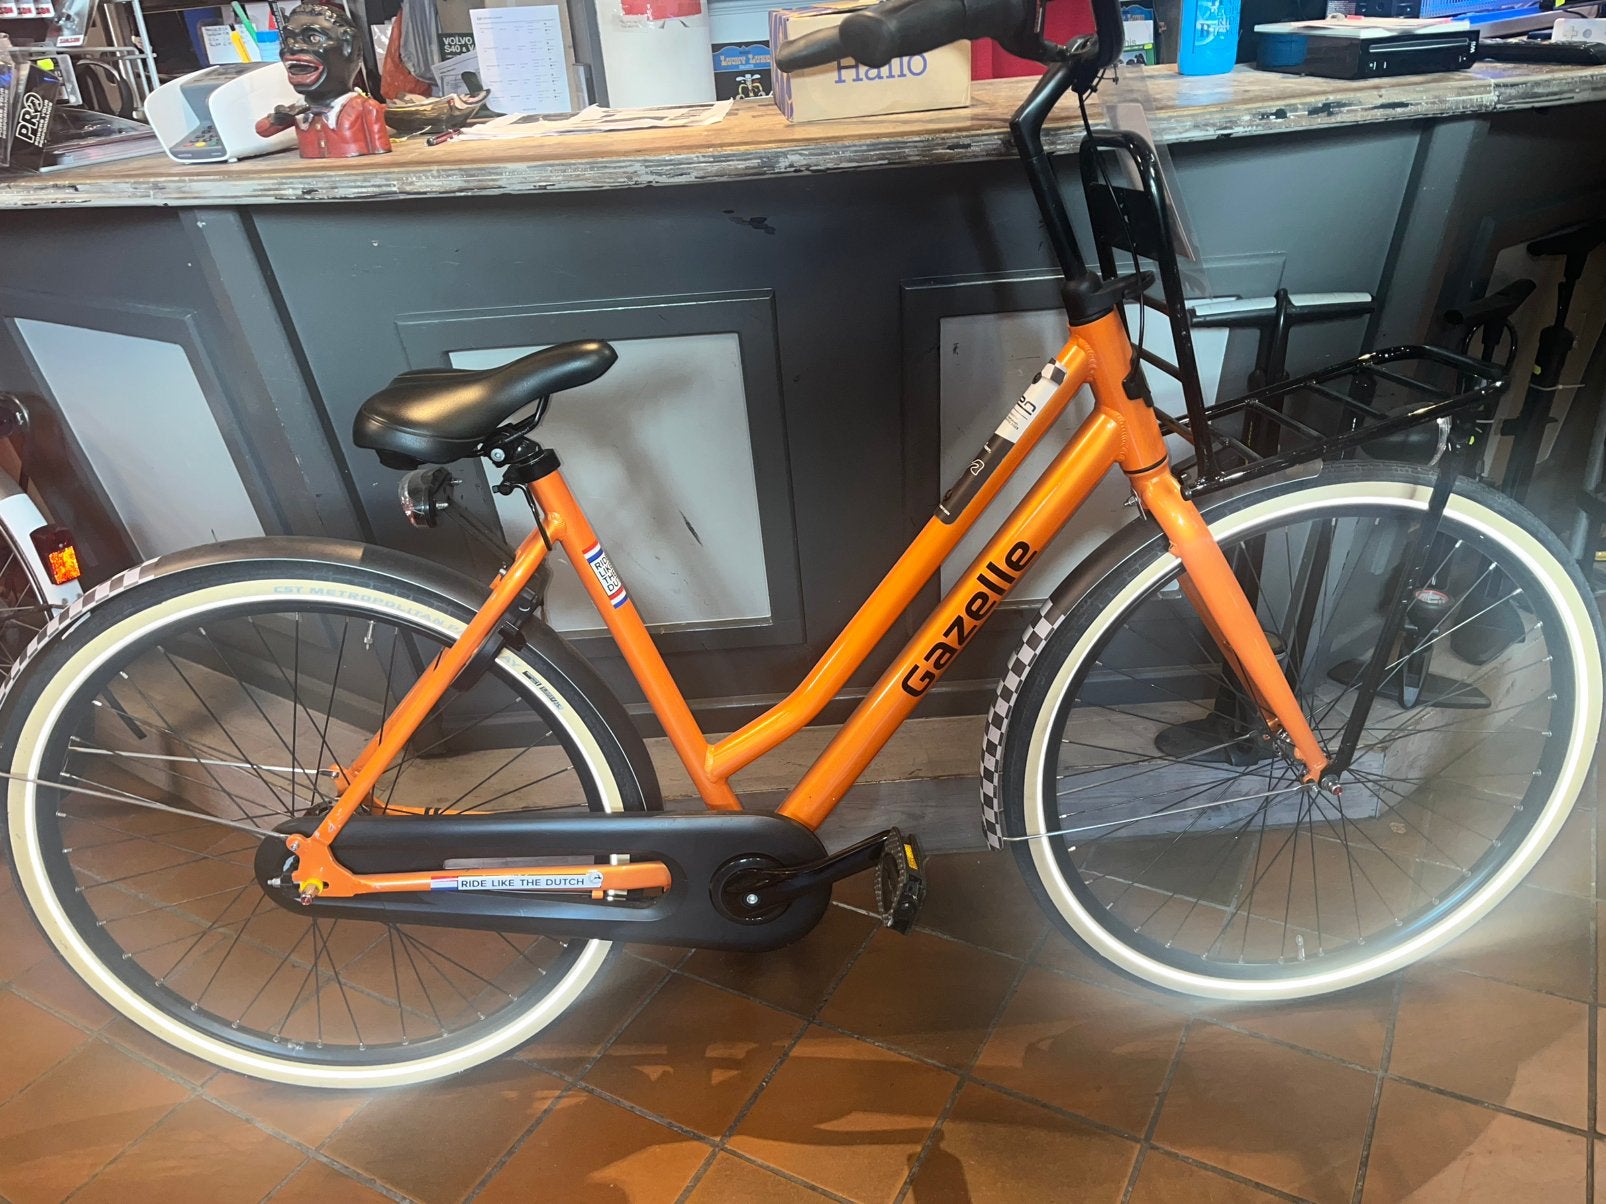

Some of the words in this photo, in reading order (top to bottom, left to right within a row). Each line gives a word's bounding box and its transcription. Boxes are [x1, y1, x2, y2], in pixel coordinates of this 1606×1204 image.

[442, 36, 473, 45] VOLVO
[444, 45, 461, 53] S40
[41, 99, 49, 117] YOUR
[16, 92, 43, 143] PRO
[594, 556, 609, 571] RID
[274, 585, 303, 594] CST
[310, 587, 446, 627] METROPOLITAN
[901, 540, 1038, 698] Gazelle
[461, 879, 487, 888] RIDE
[491, 879, 515, 888] LIKE
[520, 879, 541, 887] THE
[545, 878, 585, 887] DUTCH
